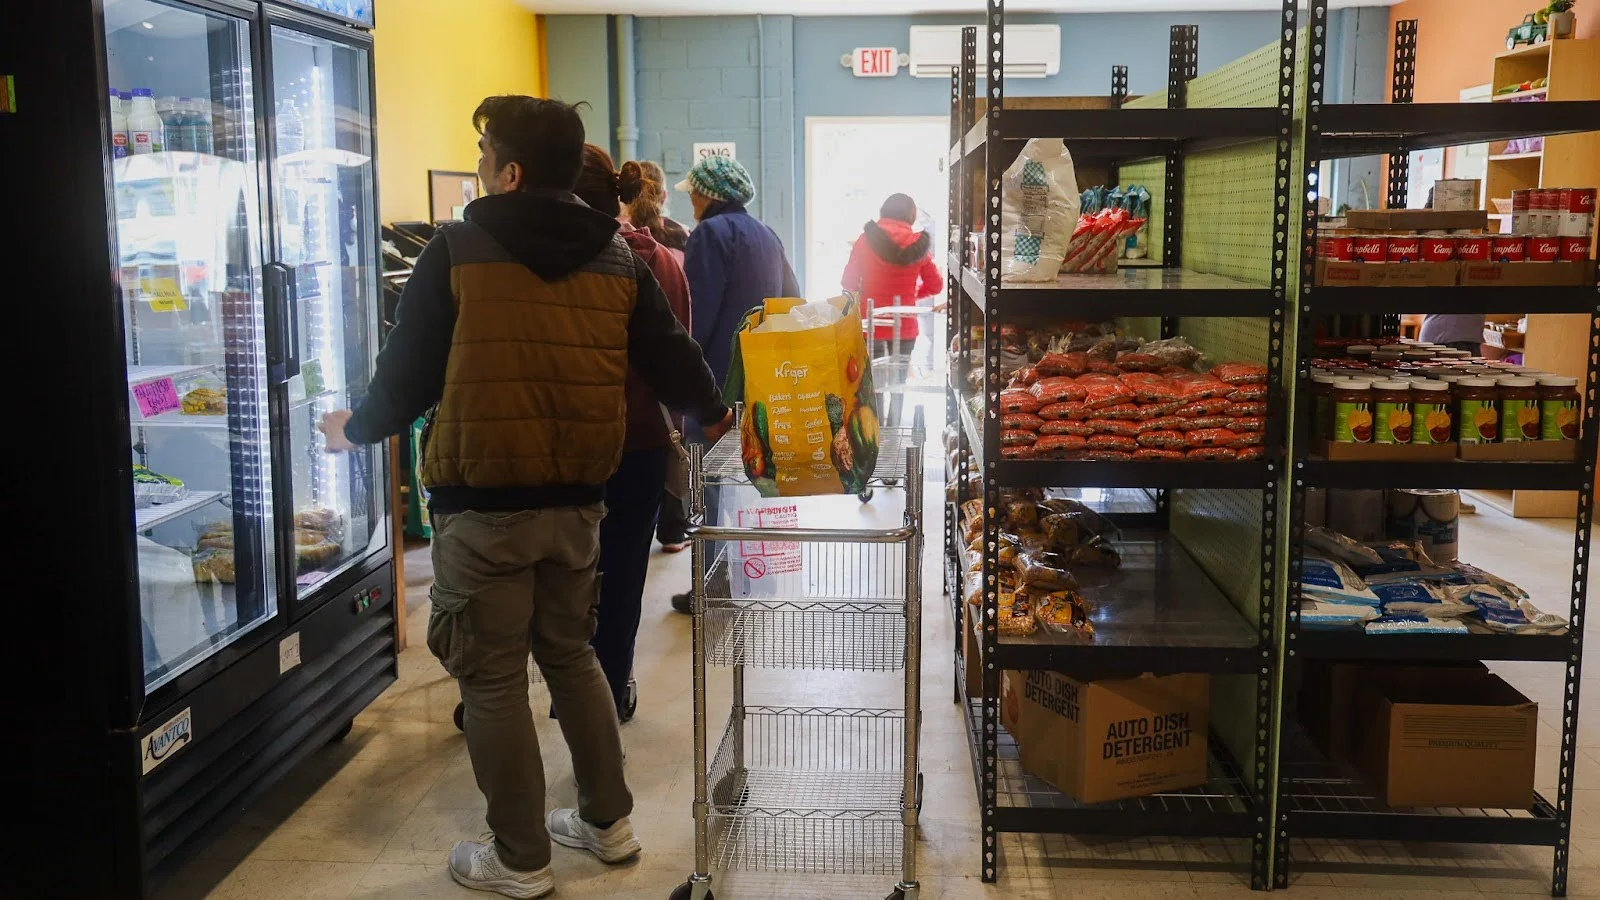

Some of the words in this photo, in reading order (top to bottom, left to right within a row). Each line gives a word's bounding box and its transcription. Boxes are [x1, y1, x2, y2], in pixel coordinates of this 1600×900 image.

[861, 49, 892, 73] EXIT
[775, 361, 809, 385] Kroger
[1026, 670, 1052, 690] AUTO
[1054, 678, 1079, 704] DISH
[1025, 682, 1081, 724] DETERGENT
[144, 716, 190, 761] AVANTCO
[1106, 717, 1149, 740] AUTO
[1153, 712, 1191, 733] DISH
[1102, 729, 1193, 760] DETERGENT
